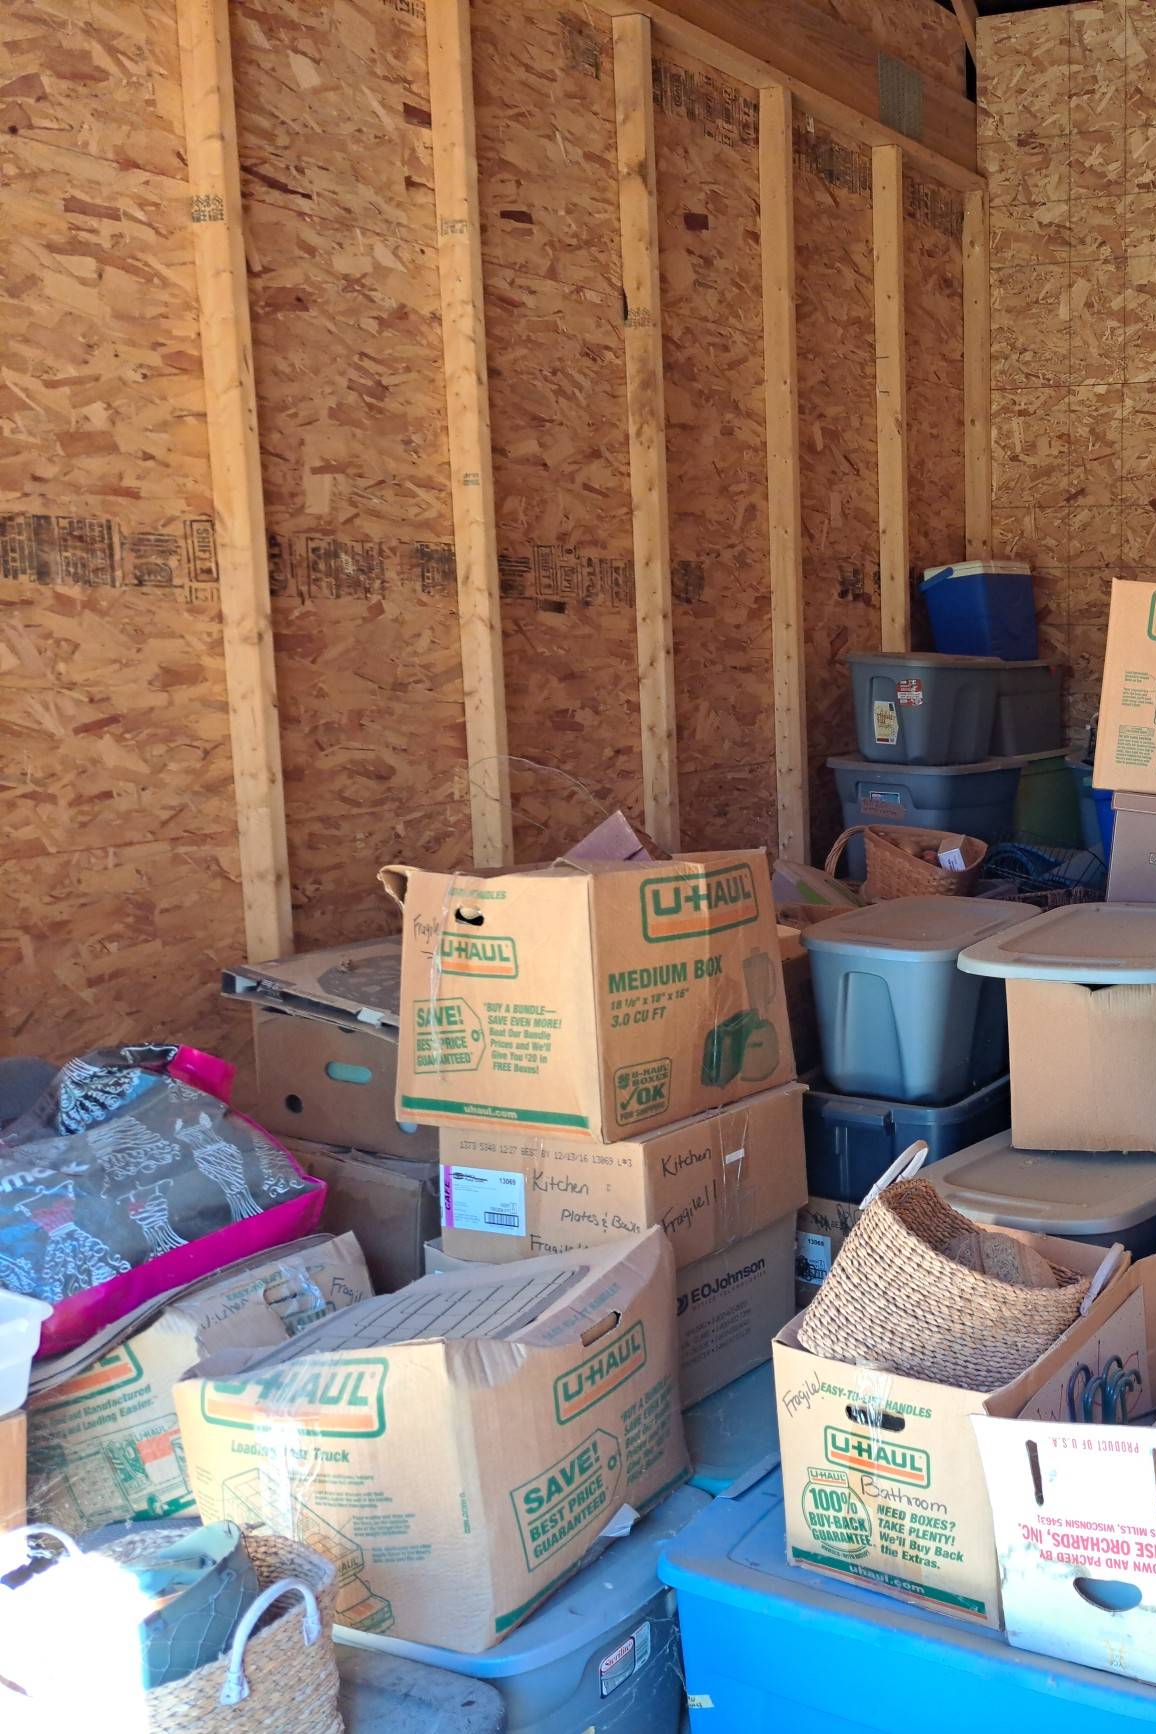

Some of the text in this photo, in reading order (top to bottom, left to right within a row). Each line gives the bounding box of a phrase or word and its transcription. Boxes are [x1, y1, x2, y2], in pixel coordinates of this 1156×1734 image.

[652, 875, 752, 916] U-HAUL
[440, 938, 511, 962] U-HAUL
[608, 955, 722, 994] MEDIUM BOX
[416, 1005, 465, 1028] SAVE!
[488, 1015, 508, 1026] SAVE
[510, 1017, 531, 1027] EVEN
[611, 1006, 667, 1028] 3.0 CU FT
[636, 1083, 665, 1105] OK
[464, 1104, 518, 1119] uhaul.com
[661, 1147, 712, 1178] Kitchen
[532, 1168, 589, 1196] Kitchen
[561, 1208, 600, 1226] Plates
[331, 1277, 363, 1303] Fragil
[562, 1332, 641, 1403] U-HAUL
[83, 1384, 151, 1417] Manufactured
[884, 1399, 933, 1419] HANDLES
[82, 1411, 118, 1430] Loading
[314, 1448, 350, 1463] Truck
[831, 1433, 923, 1473] U-HAUL
[1082, 1438, 1094, 1451] OF
[1098, 1439, 1140, 1454] PRODUCT
[523, 1440, 601, 1515] SAVE!
[810, 1468, 845, 1482] U-HAUL
[809, 1487, 859, 1515] 100%
[860, 1474, 948, 1515] Bathroom
[529, 1476, 604, 1542] BEST PRICE
[876, 1504, 957, 1531] NEED BOXES?
[1036, 1514, 1064, 1527] 54631
[533, 1490, 607, 1559] GUARANTEED
[809, 1511, 868, 1533] BUY-BACK
[878, 1518, 956, 1546] TAKE PLENTY!
[1017, 1522, 1044, 1545] INC.
[1065, 1515, 1116, 1533] WISCONSIN
[1117, 1523, 1149, 1537] MILLS,
[879, 1531, 964, 1562] We'll Buy Back
[1039, 1548, 1054, 1560] BY
[1046, 1529, 1132, 1556] ORCHARDS,
[880, 1545, 899, 1557] the
[901, 1550, 941, 1569] Extras.
[1056, 1551, 1102, 1568] PACKED
[1105, 1557, 1130, 1571] AND
[849, 1564, 926, 1594] uhaul.com
